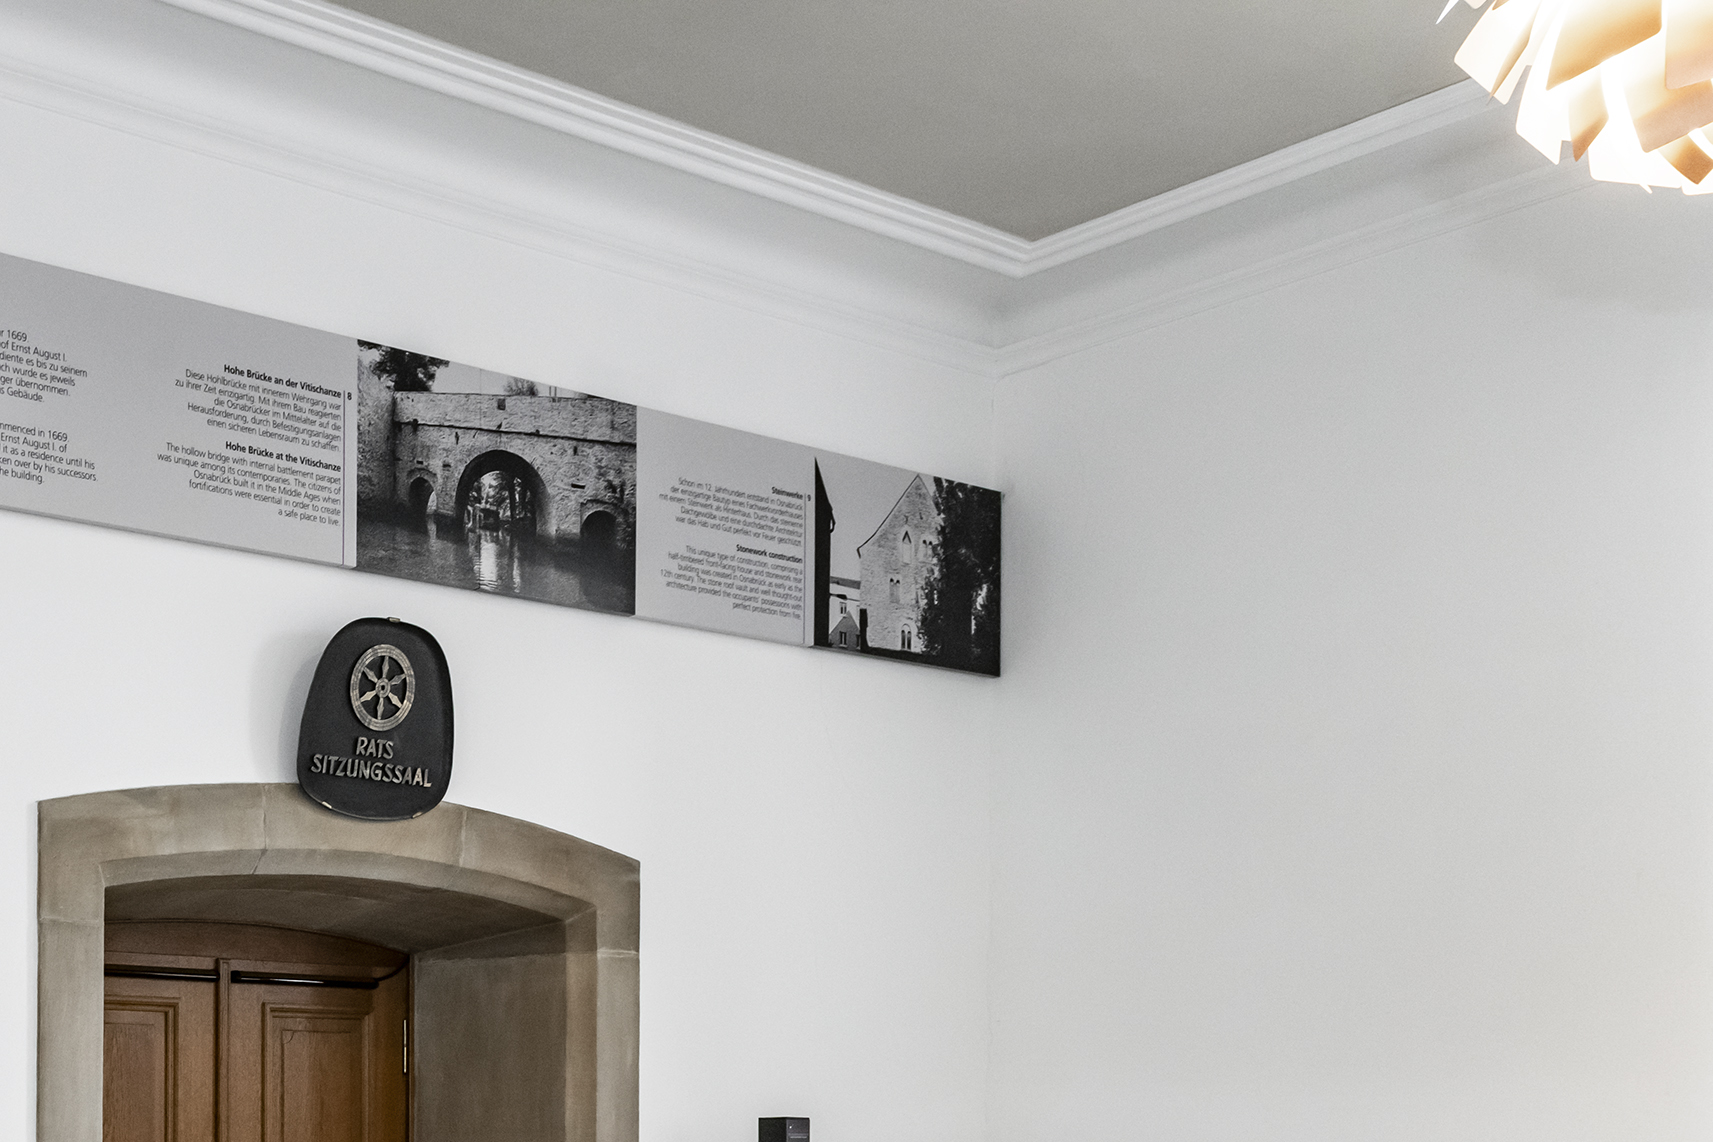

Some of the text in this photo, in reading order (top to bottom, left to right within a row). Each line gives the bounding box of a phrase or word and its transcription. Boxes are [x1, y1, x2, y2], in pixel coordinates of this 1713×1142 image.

[223, 364, 342, 398] Hohe Brücke an der Vitischanze
[347, 392, 352, 401] 8
[224, 442, 341, 472] Hohe Brücke at the Vitischanze
[736, 544, 803, 564] Stonework construction
[356, 736, 394, 759] RATS
[310, 753, 432, 787] SITZUNGSSAAL
